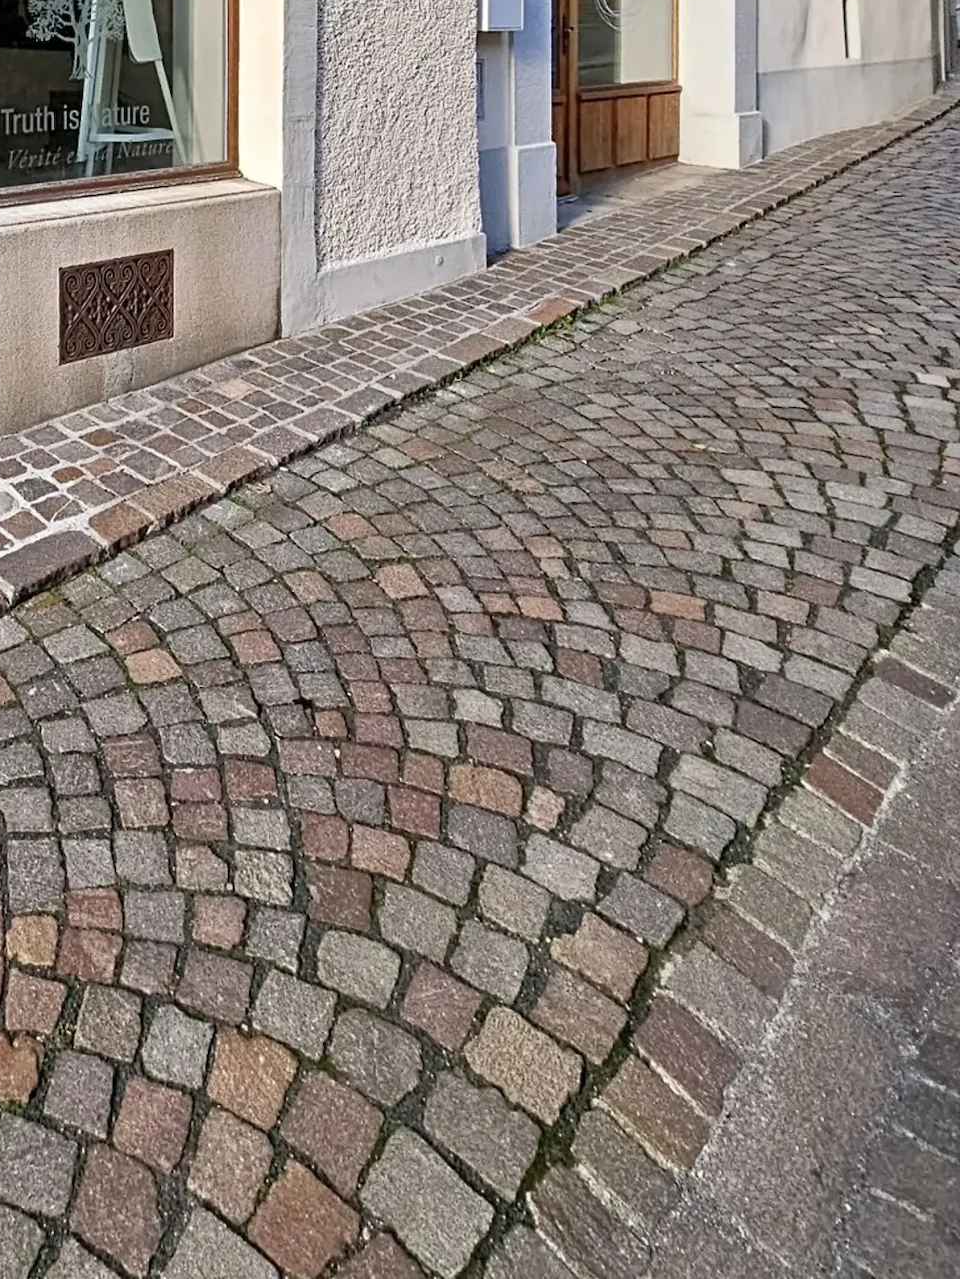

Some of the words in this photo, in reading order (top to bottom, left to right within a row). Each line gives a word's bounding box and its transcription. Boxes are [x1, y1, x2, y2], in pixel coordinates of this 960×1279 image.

[1, 104, 55, 135] Truth
[63, 104, 79, 130] is
[7, 145, 61, 170] Vérité
